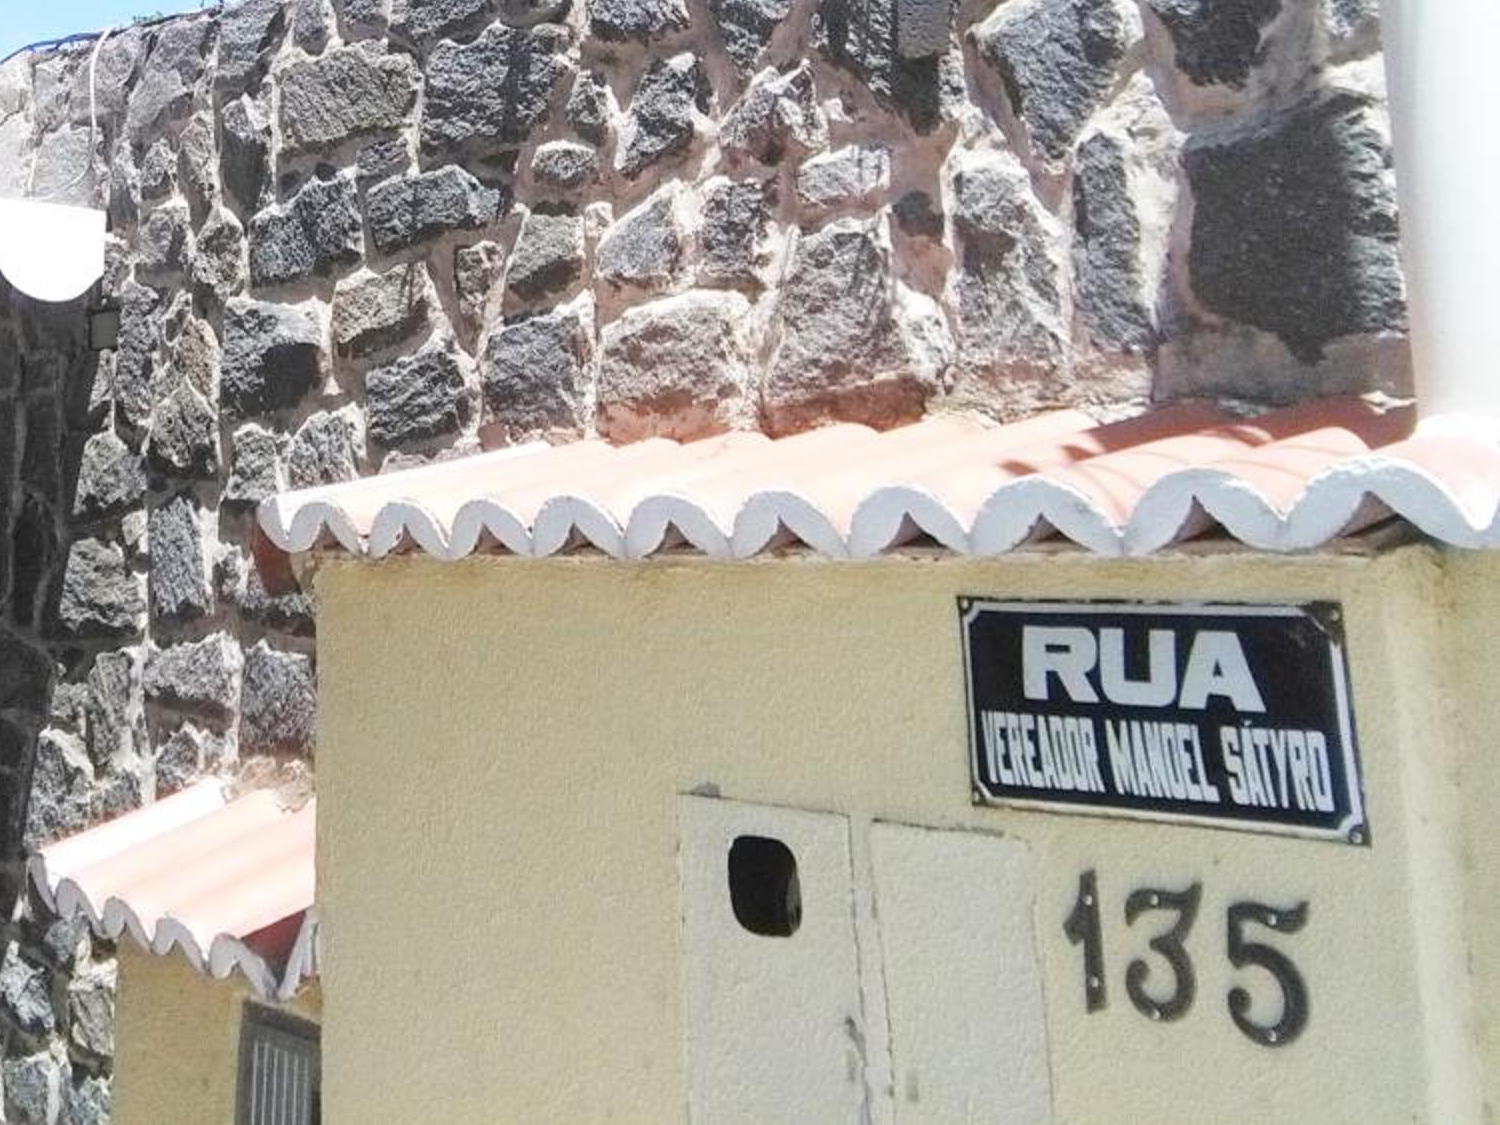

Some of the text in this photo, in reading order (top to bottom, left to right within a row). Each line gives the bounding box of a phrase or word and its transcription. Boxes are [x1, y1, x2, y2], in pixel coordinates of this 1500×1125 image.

[1022, 624, 1267, 713] RUA
[981, 709, 1335, 813] VEREADOR MANOEL SÁTYRO
[1062, 868, 1311, 1048] 135
